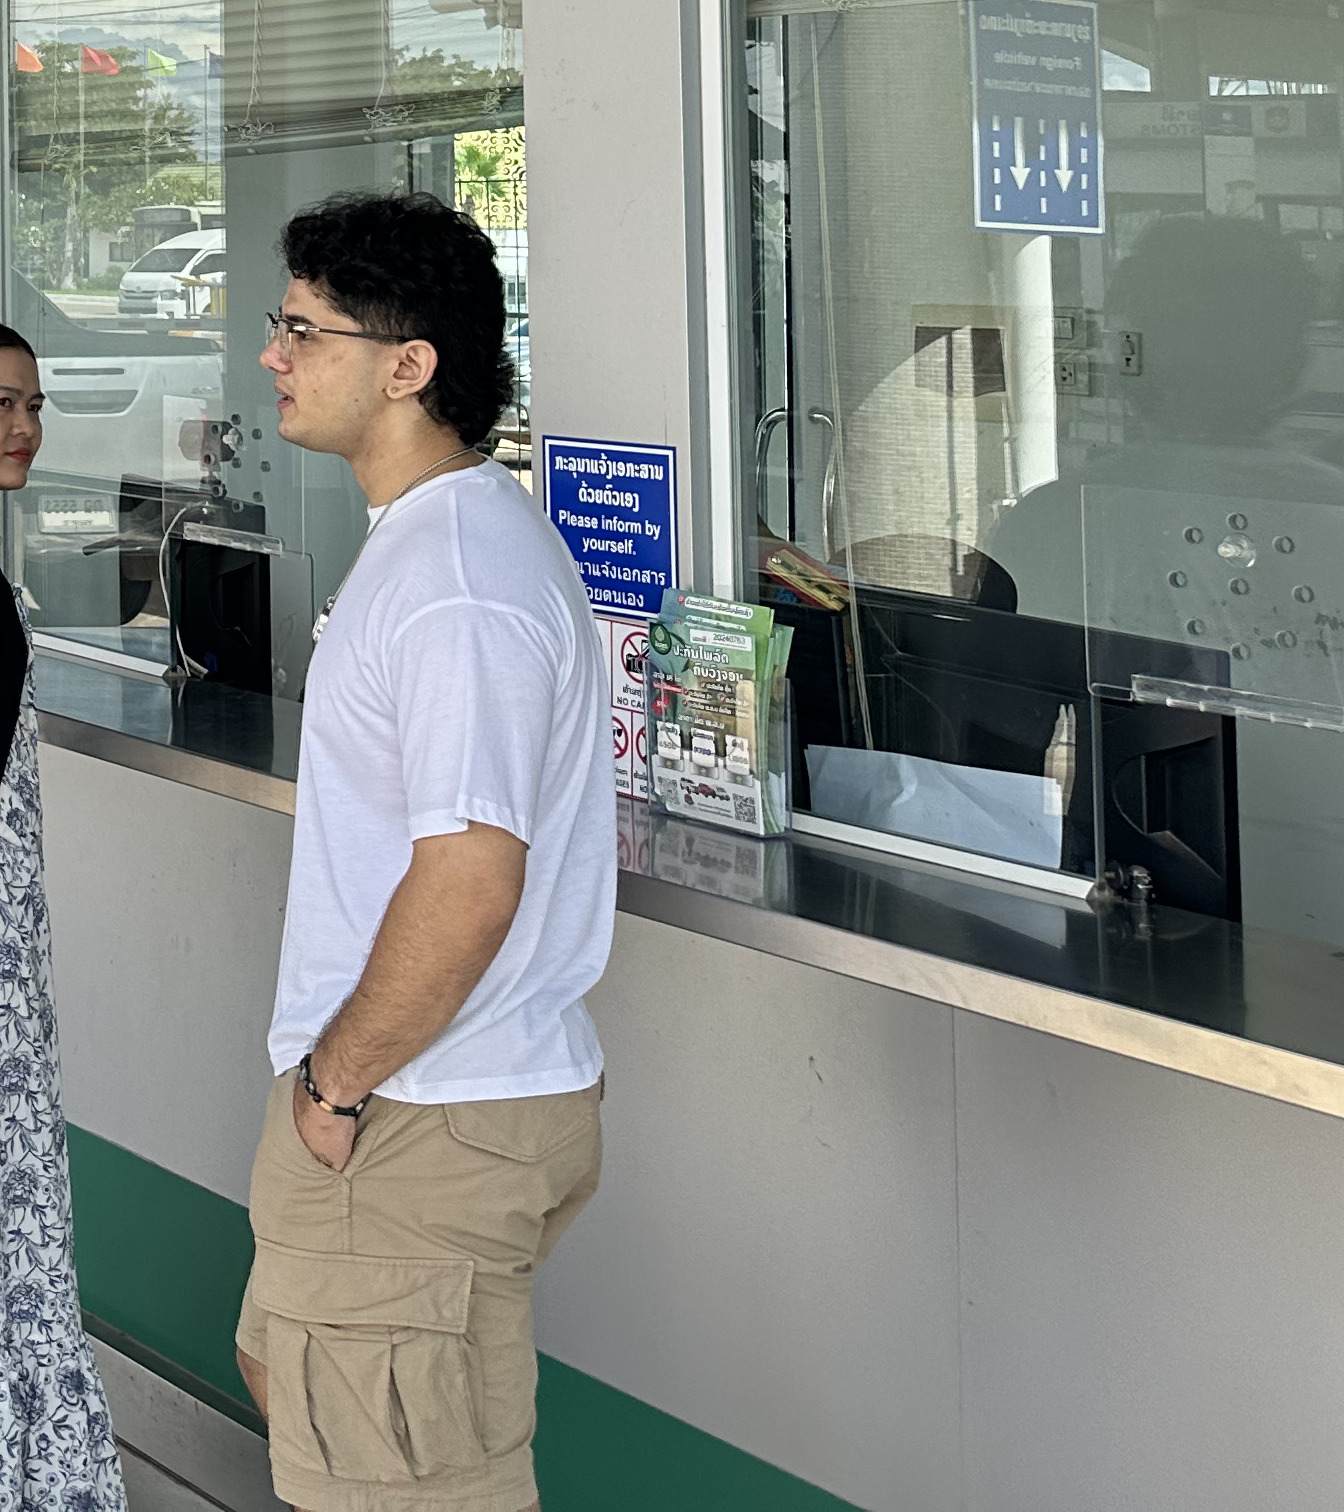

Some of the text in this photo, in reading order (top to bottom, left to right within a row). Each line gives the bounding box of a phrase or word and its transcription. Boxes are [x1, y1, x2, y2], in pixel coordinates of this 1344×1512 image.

[558, 510, 661, 541] Please inform by
[582, 537, 637, 556] yourself.
